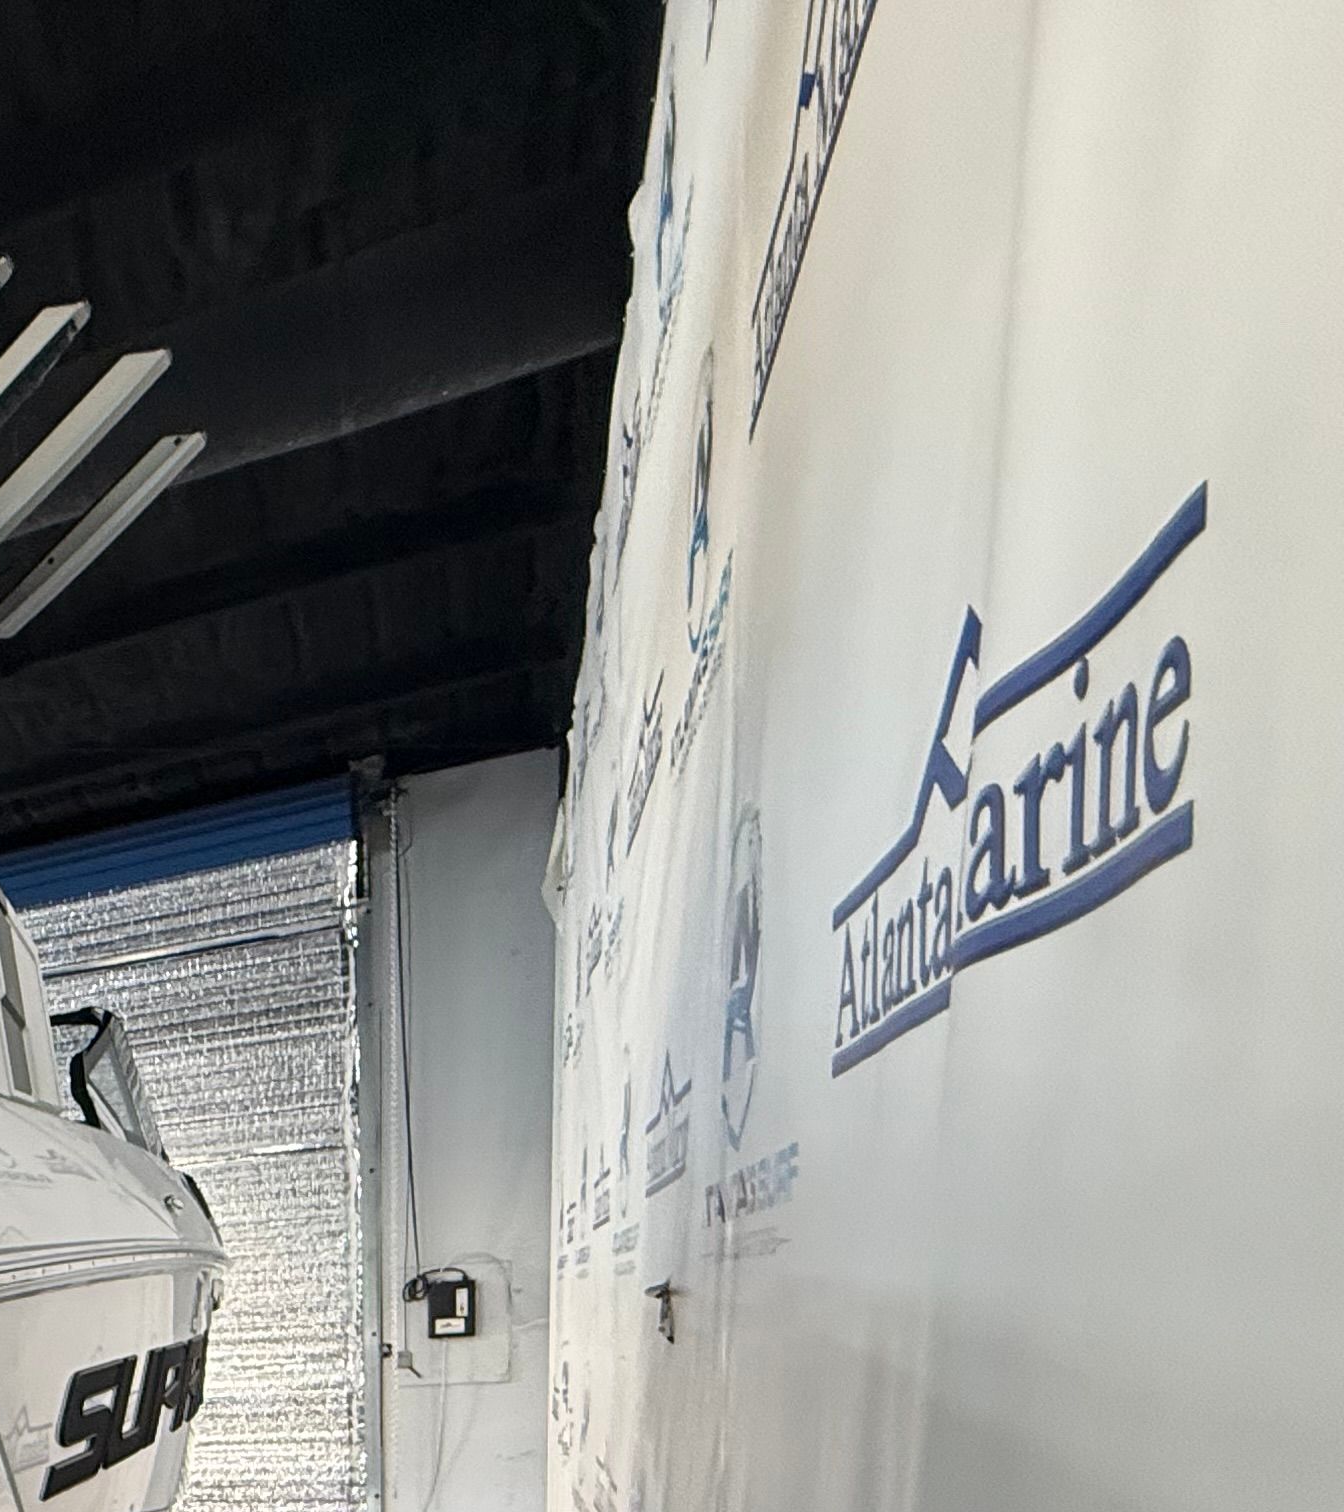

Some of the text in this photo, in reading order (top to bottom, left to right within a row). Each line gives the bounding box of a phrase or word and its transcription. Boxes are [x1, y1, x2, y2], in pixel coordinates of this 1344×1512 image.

[834, 857, 955, 1049] Atlanta
[957, 634, 1193, 932] arine
[38, 1333, 208, 1502] SUPR
